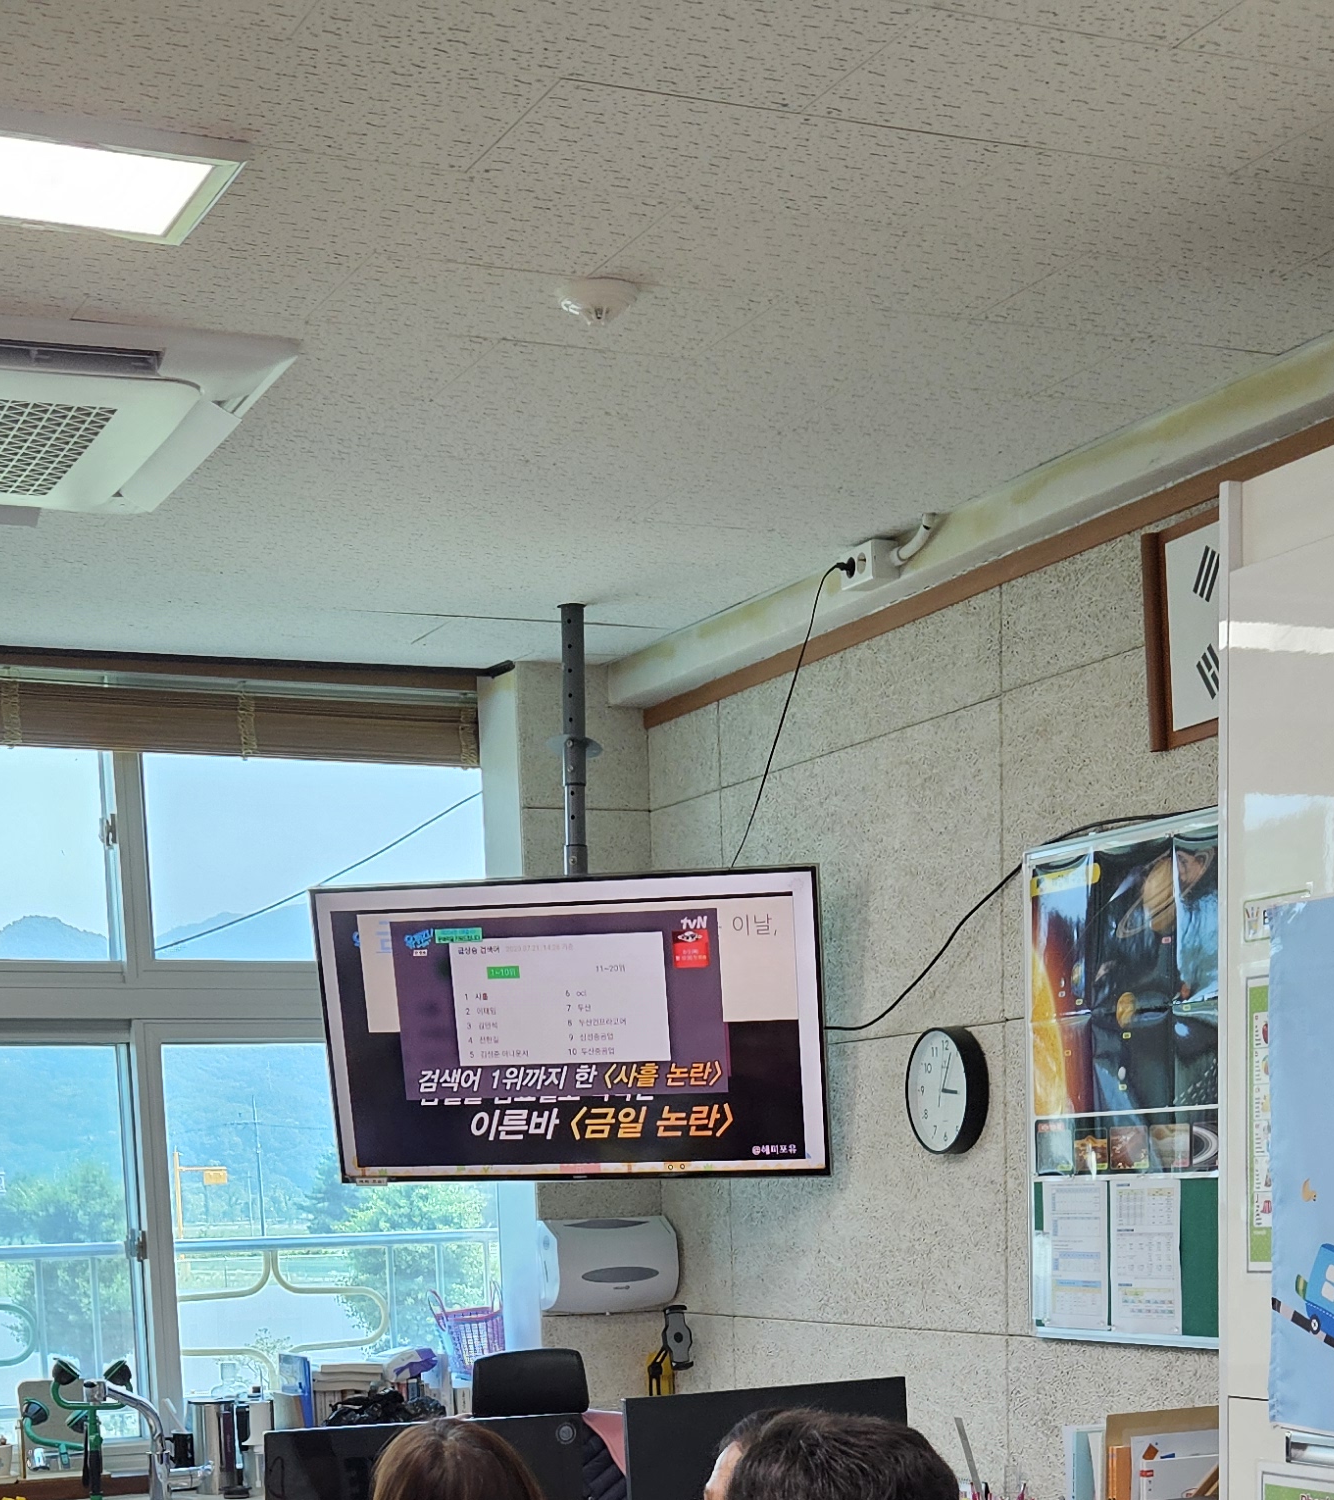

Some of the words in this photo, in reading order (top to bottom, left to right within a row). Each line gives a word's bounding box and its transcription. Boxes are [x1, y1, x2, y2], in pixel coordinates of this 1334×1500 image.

[681, 916, 707, 929] tvN
[942, 1040, 949, 1051] 12
[931, 1047, 938, 1057] 11
[924, 1063, 932, 1073] 10
[418, 1068, 480, 1094] 검색어
[490, 1066, 567, 1091] 1위까지
[575, 1066, 598, 1089] 한
[921, 1086, 924, 1096] 9
[924, 1109, 928, 1120] 8
[470, 1107, 560, 1141] 이른바
[933, 1125, 937, 1135] 7
[943, 1131, 948, 1141] 6
